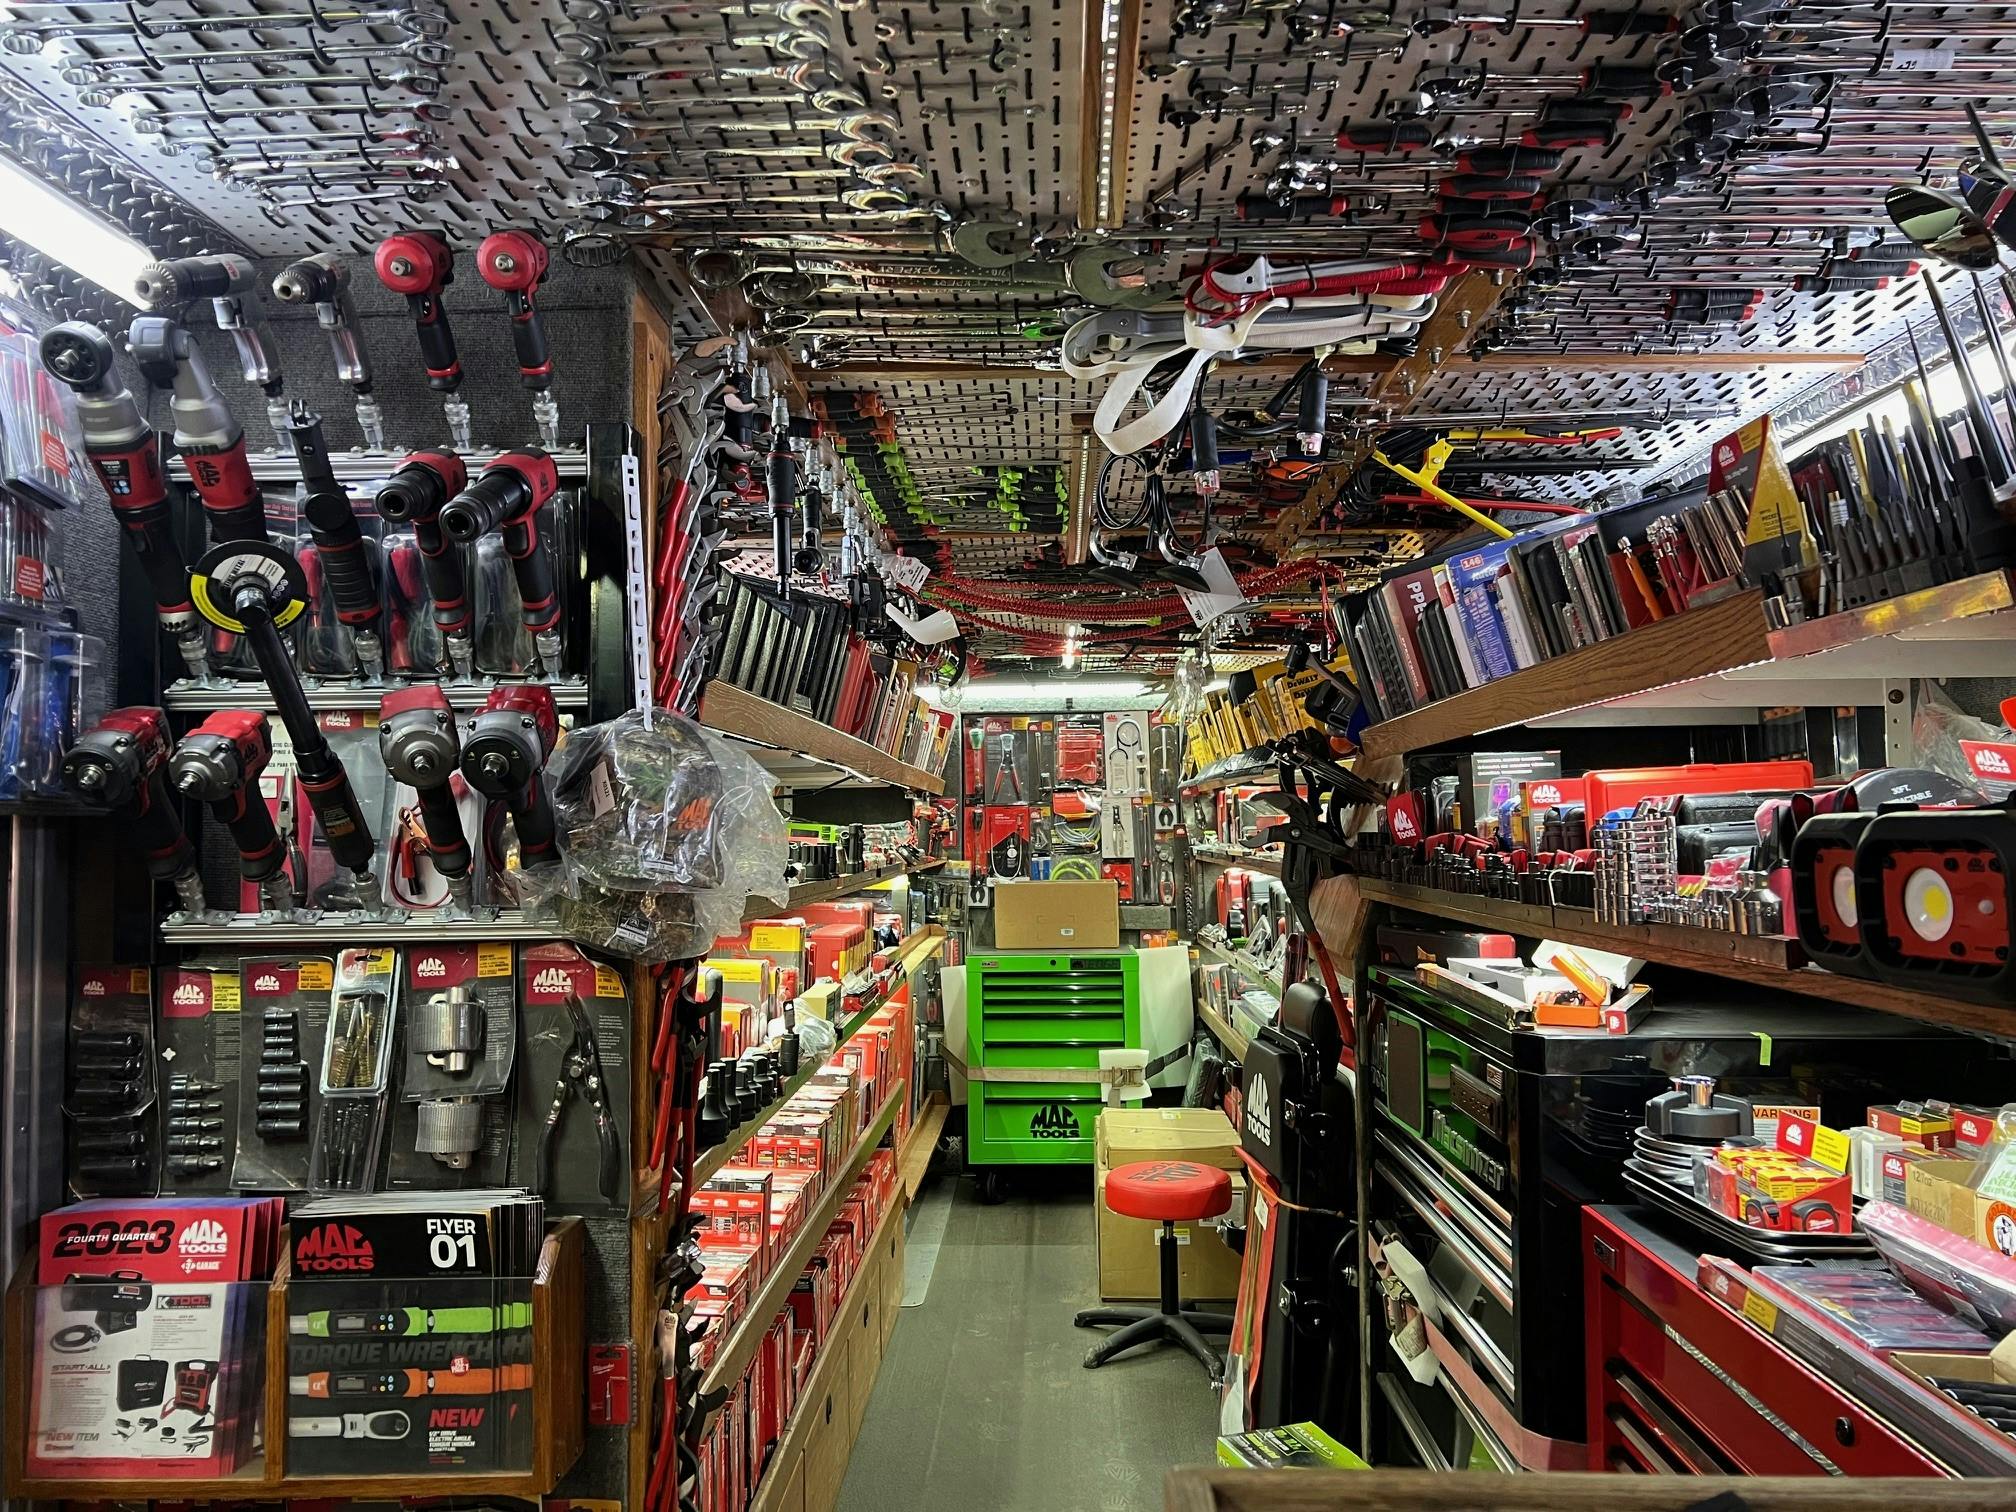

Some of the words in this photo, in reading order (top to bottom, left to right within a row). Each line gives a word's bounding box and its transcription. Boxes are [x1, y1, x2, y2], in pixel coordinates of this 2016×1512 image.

[325, 710, 350, 721] MAC
[1974, 749, 2010, 768] MAC
[1979, 765, 2011, 775] TOOLS
[1532, 784, 1561, 798] MAC
[1393, 808, 1414, 831] MAC
[1396, 829, 1417, 840] TOOLS
[417, 957, 446, 972] MAC
[254, 974, 280, 985] MAC
[533, 967, 572, 986] MAC
[83, 980, 105, 991] MAC
[172, 983, 205, 1000] MAC
[532, 985, 572, 993] TOOLS
[1247, 1072, 1271, 1128] MAC
[1029, 1104, 1079, 1129] MAC
[1030, 1128, 1080, 1139] TOOLS
[1246, 1113, 1271, 1146] TOOLS
[178, 1219, 228, 1244] MAC
[427, 1218, 477, 1235] FLYER
[67, 1234, 109, 1244] FOURTH
[112, 1232, 156, 1242] QUARTER
[296, 1223, 374, 1258] MAC
[178, 1243, 228, 1254] TOOLS
[429, 1234, 477, 1269] 01
[296, 1256, 375, 1272] TOOLS
[429, 1408, 485, 1428] NEW
[47, 1433, 75, 1442] NEW
[75, 1432, 99, 1442] ITEM
